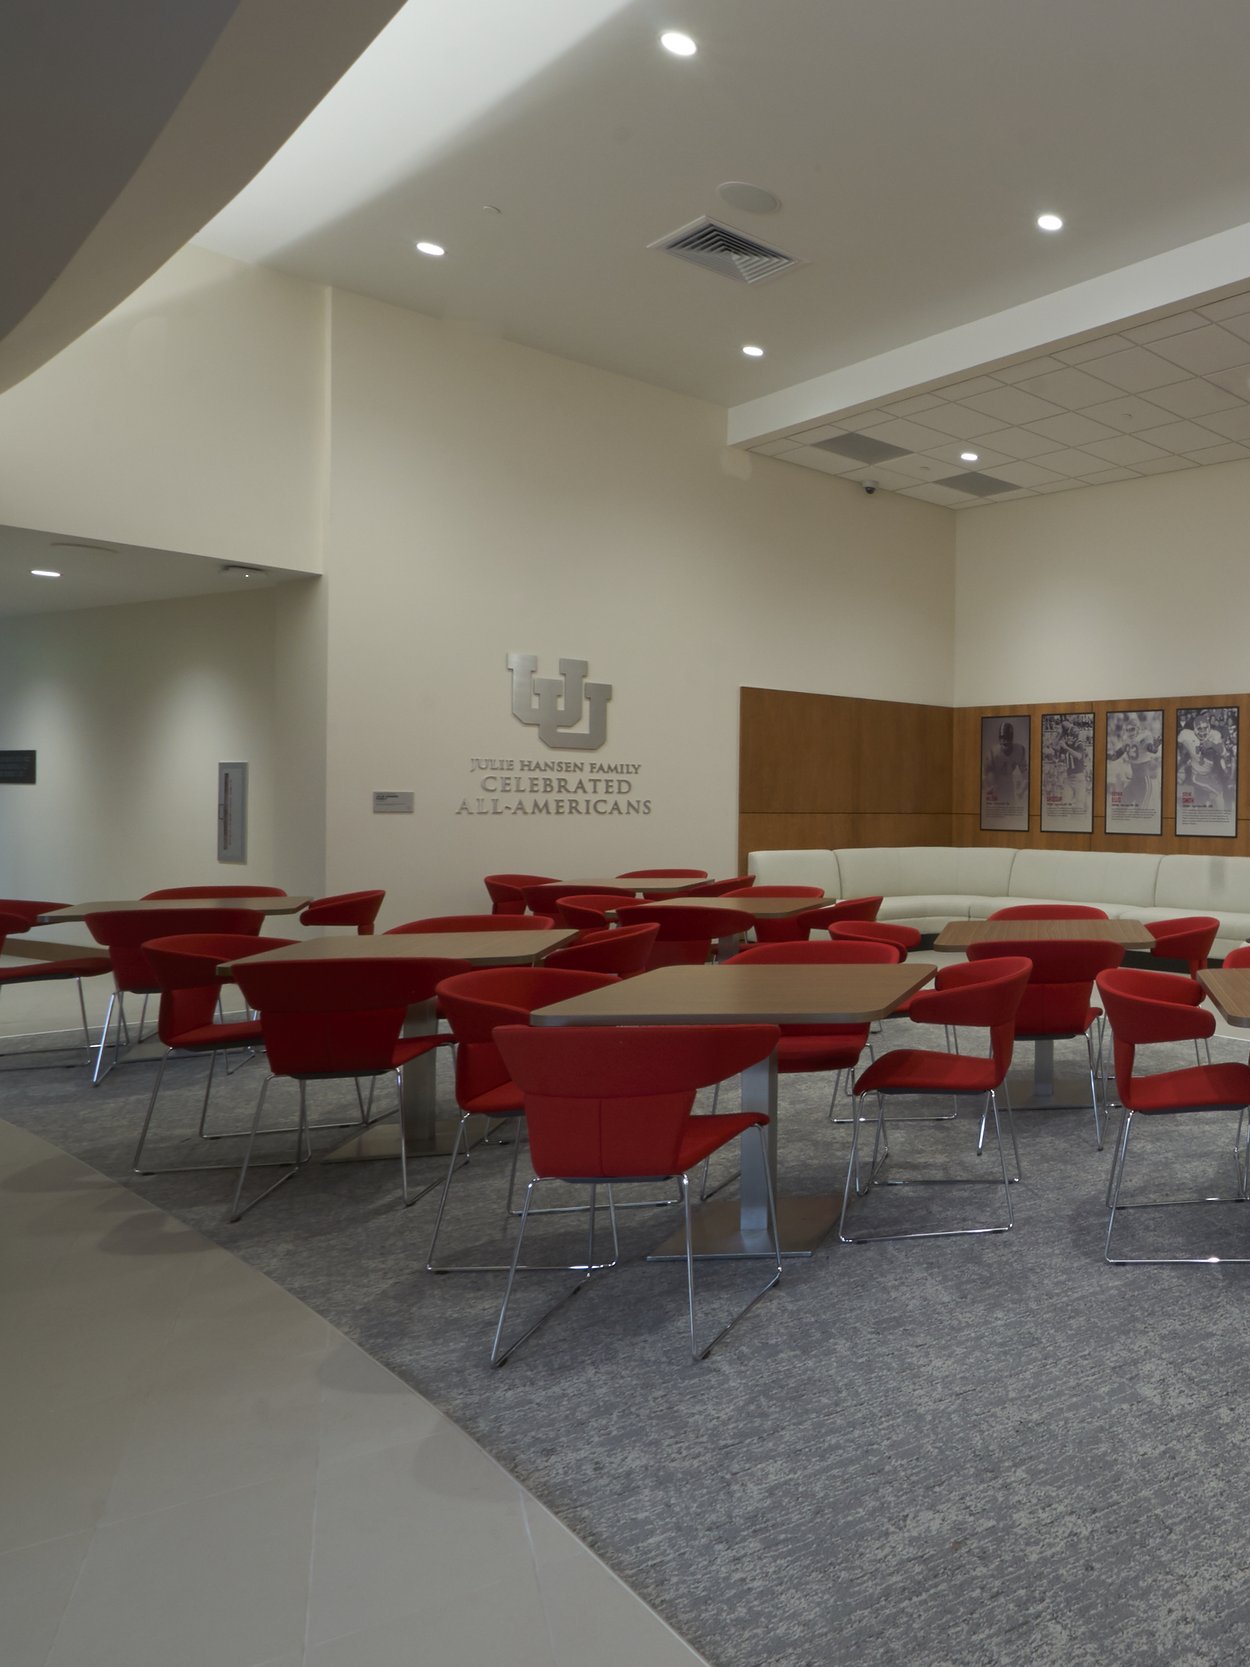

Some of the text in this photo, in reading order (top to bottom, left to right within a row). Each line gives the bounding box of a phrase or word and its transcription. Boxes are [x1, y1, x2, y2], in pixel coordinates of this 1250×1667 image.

[470, 758, 642, 775] JULIE HANSEN FAMILY
[480, 776, 633, 795] CELEBRATED
[455, 798, 653, 816] ALL-AMERICANS
